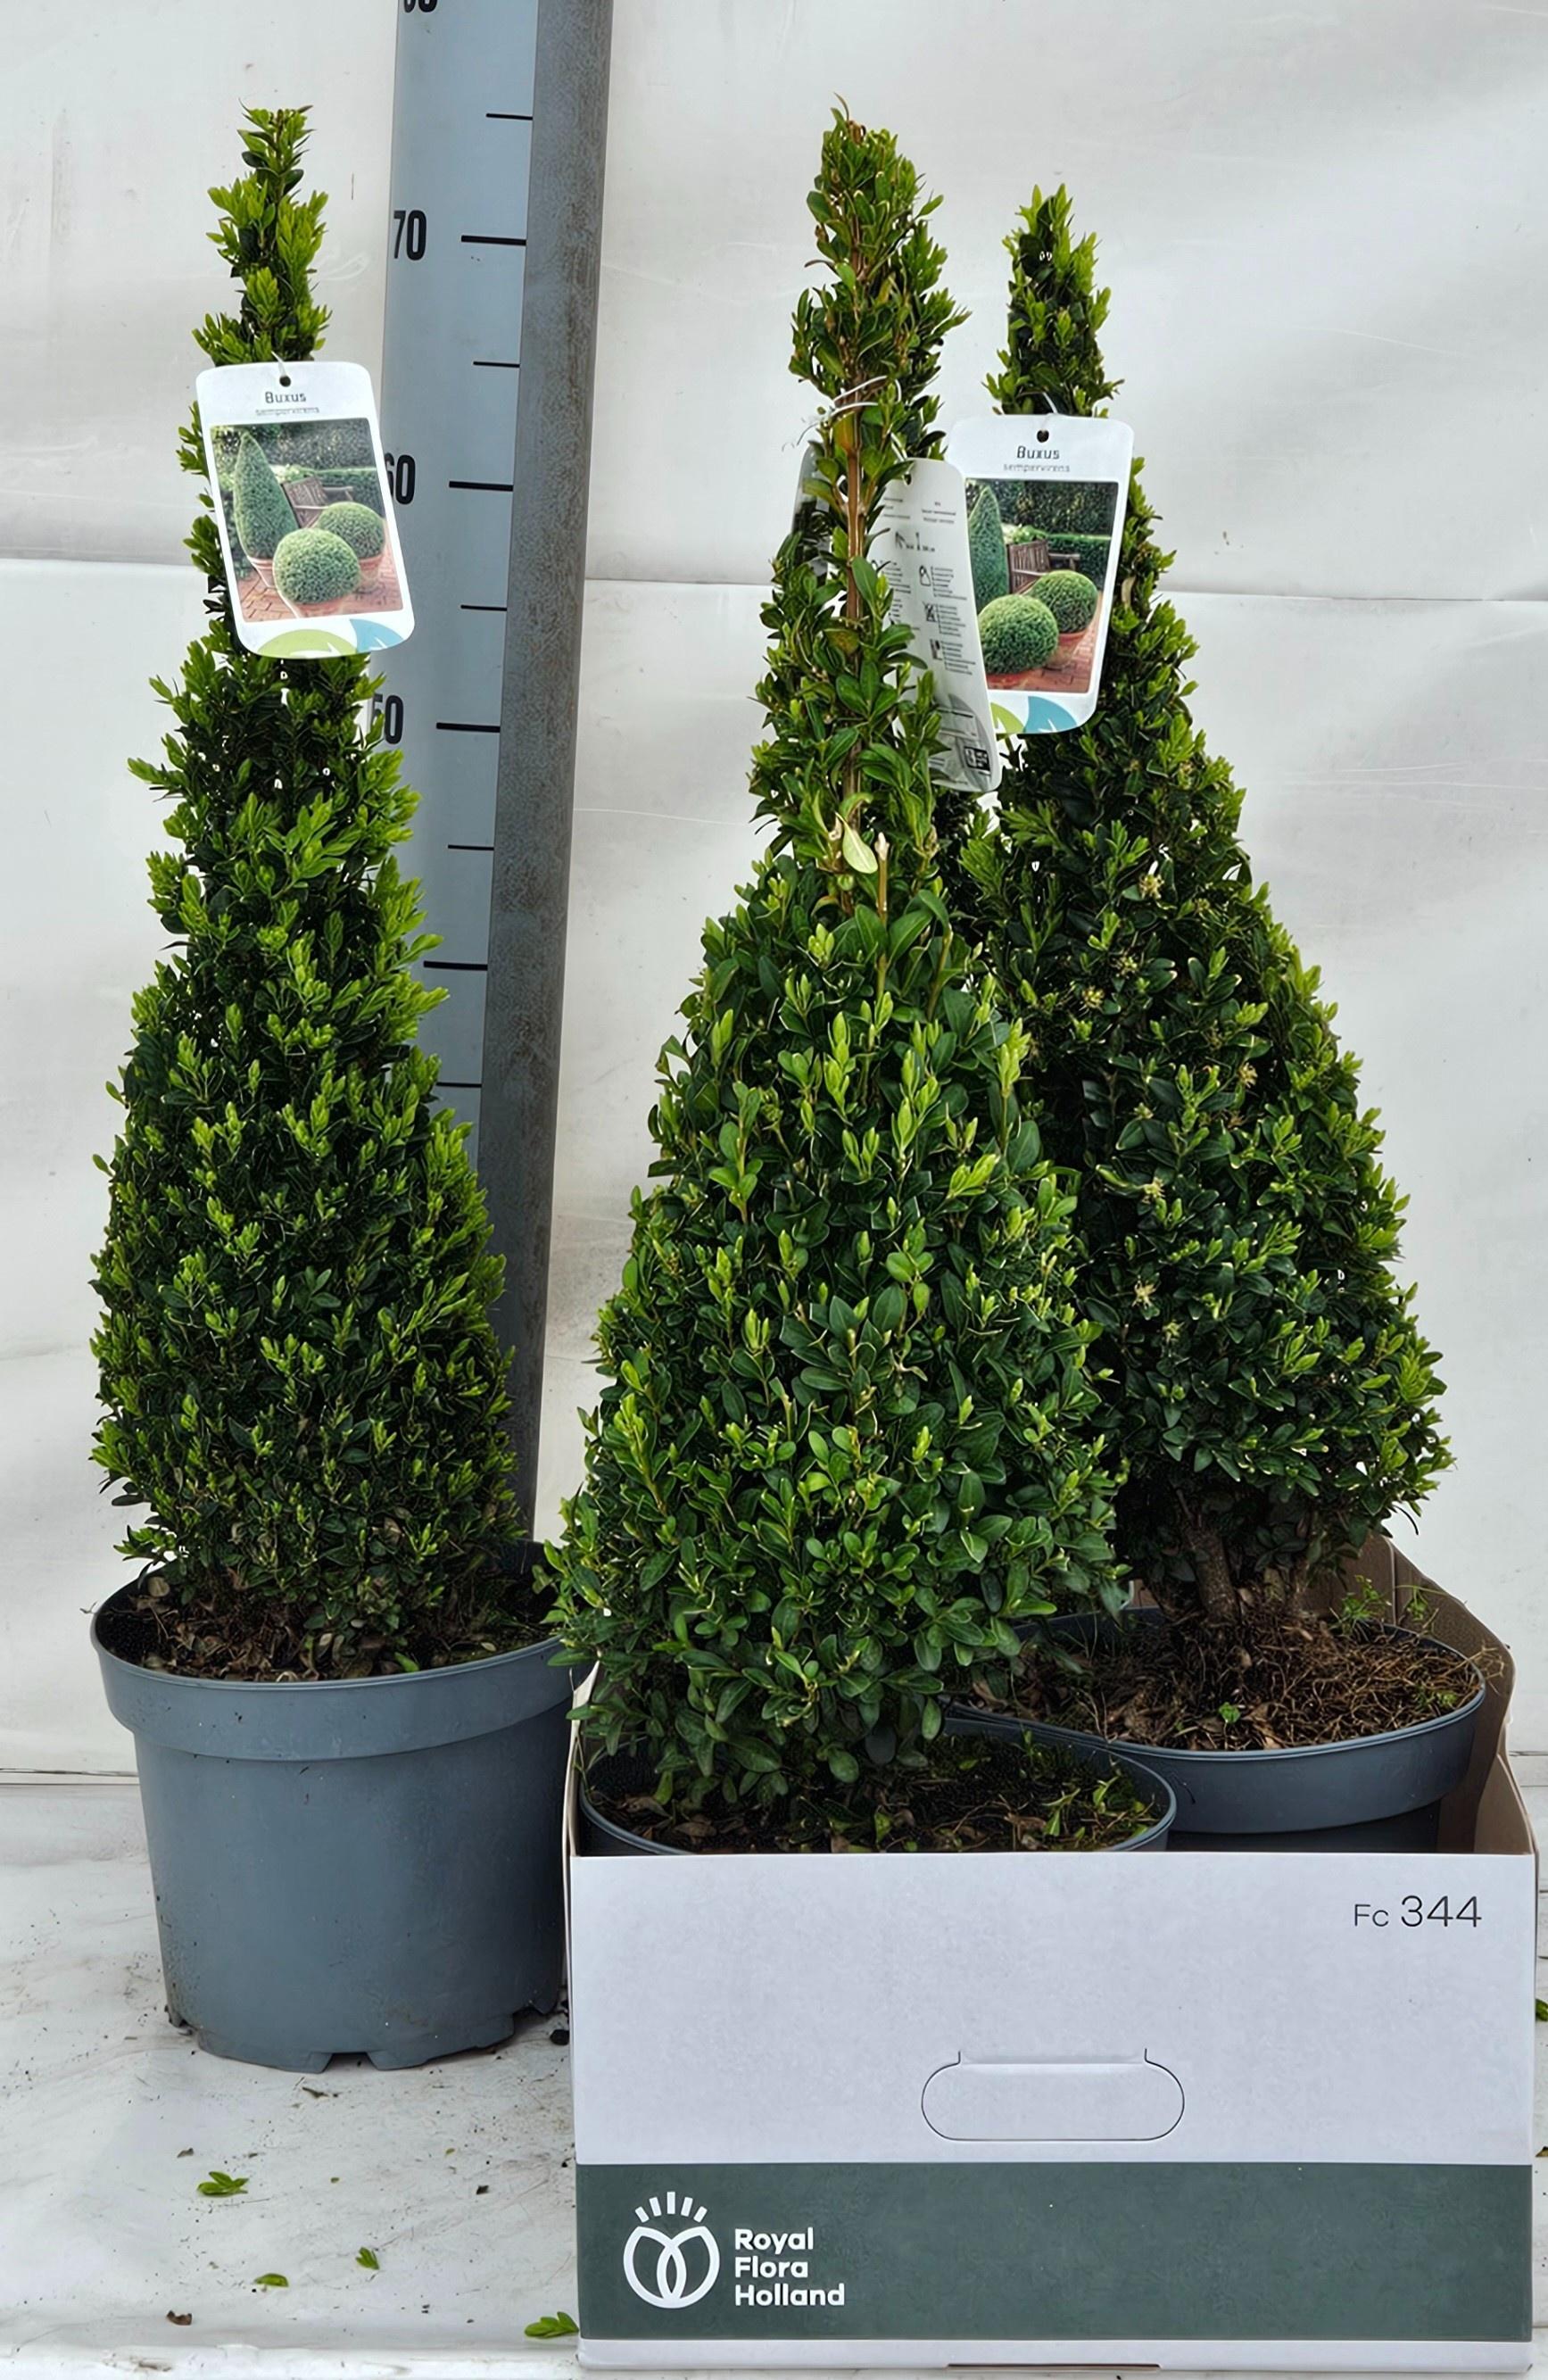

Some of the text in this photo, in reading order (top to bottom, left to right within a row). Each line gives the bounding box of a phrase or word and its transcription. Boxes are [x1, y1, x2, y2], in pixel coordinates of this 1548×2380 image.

[393, 210, 426, 260] 70
[265, 391, 307, 403] Buxus
[1016, 445, 1060, 460] Buxus
[1354, 1895, 1482, 1928] Fc 344
[734, 2227, 814, 2255] Royal
[734, 2255, 808, 2278] Flora
[734, 2283, 845, 2306] Holland
